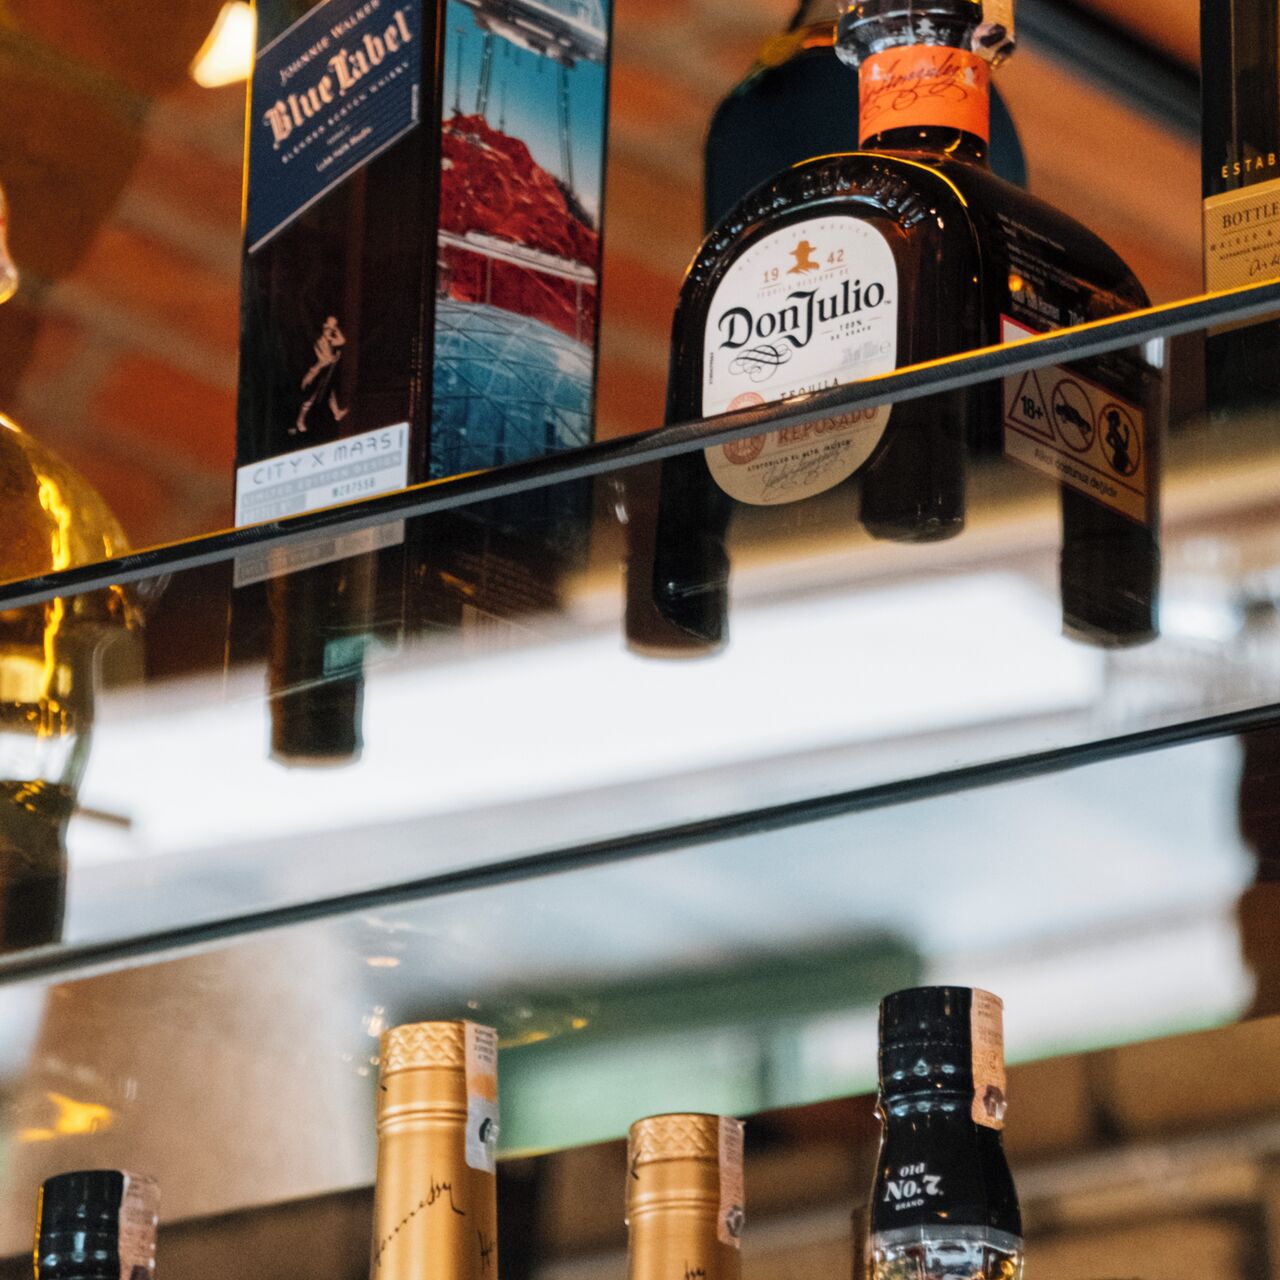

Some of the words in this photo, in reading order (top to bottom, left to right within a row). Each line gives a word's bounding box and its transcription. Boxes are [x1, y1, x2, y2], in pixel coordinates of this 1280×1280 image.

[263, 74, 334, 151] Blue
[328, 8, 414, 96] Label
[279, 36, 331, 88] JOHNNIE
[1222, 200, 1279, 229] BOTTLE
[763, 267, 780, 284] 19
[826, 248, 845, 265] 42
[1020, 395, 1043, 420] 18+
[253, 457, 301, 485] CITY
[311, 451, 325, 468] X
[333, 432, 392, 463] MARS
[895, 1198, 925, 1211] BRAND
